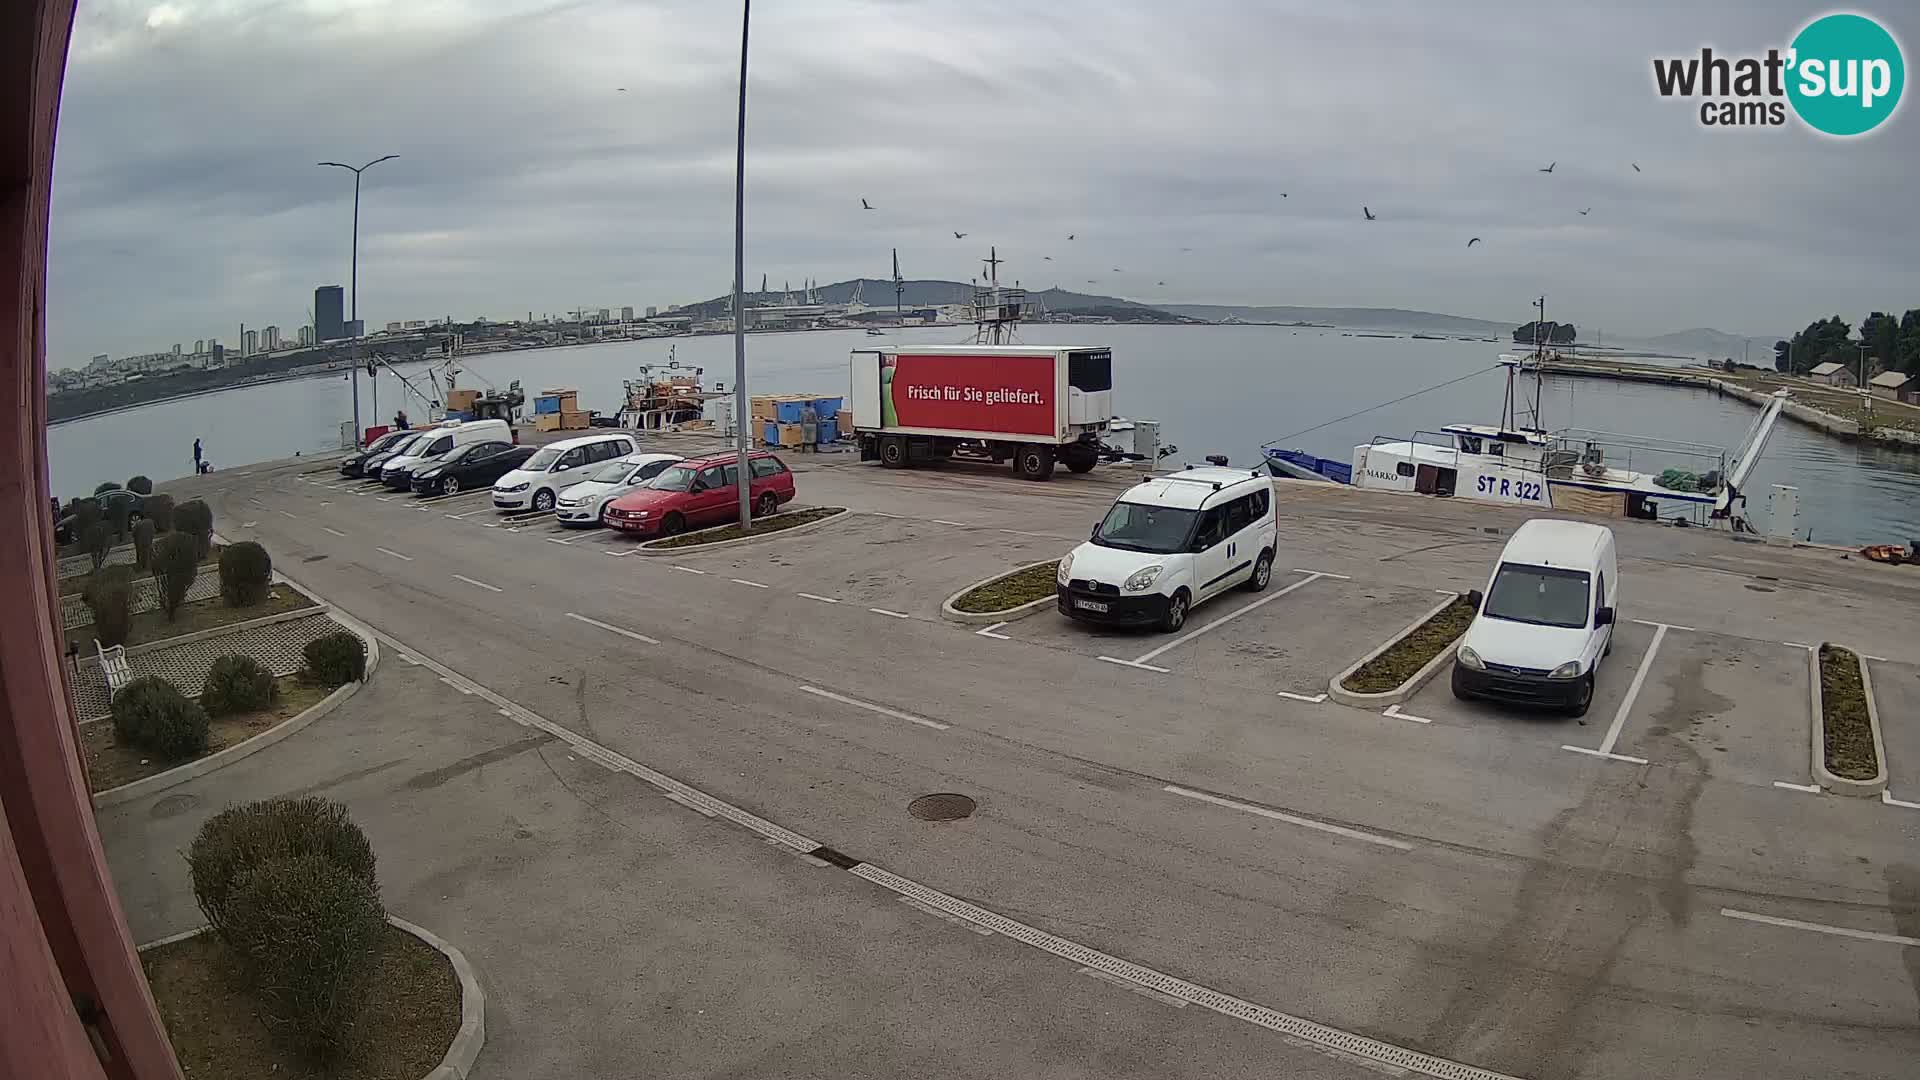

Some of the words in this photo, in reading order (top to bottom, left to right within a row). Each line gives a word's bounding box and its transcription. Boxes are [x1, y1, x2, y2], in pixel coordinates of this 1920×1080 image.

[908, 385, 941, 400] Frisch
[944, 386, 961, 401] für
[964, 387, 983, 402] Sie
[986, 388, 1044, 405] geliefert.
[1366, 468, 1398, 482] MARKO
[1477, 474, 1497, 494] ST
[1500, 478, 1511, 497] R
[1514, 480, 1541, 501] 322
